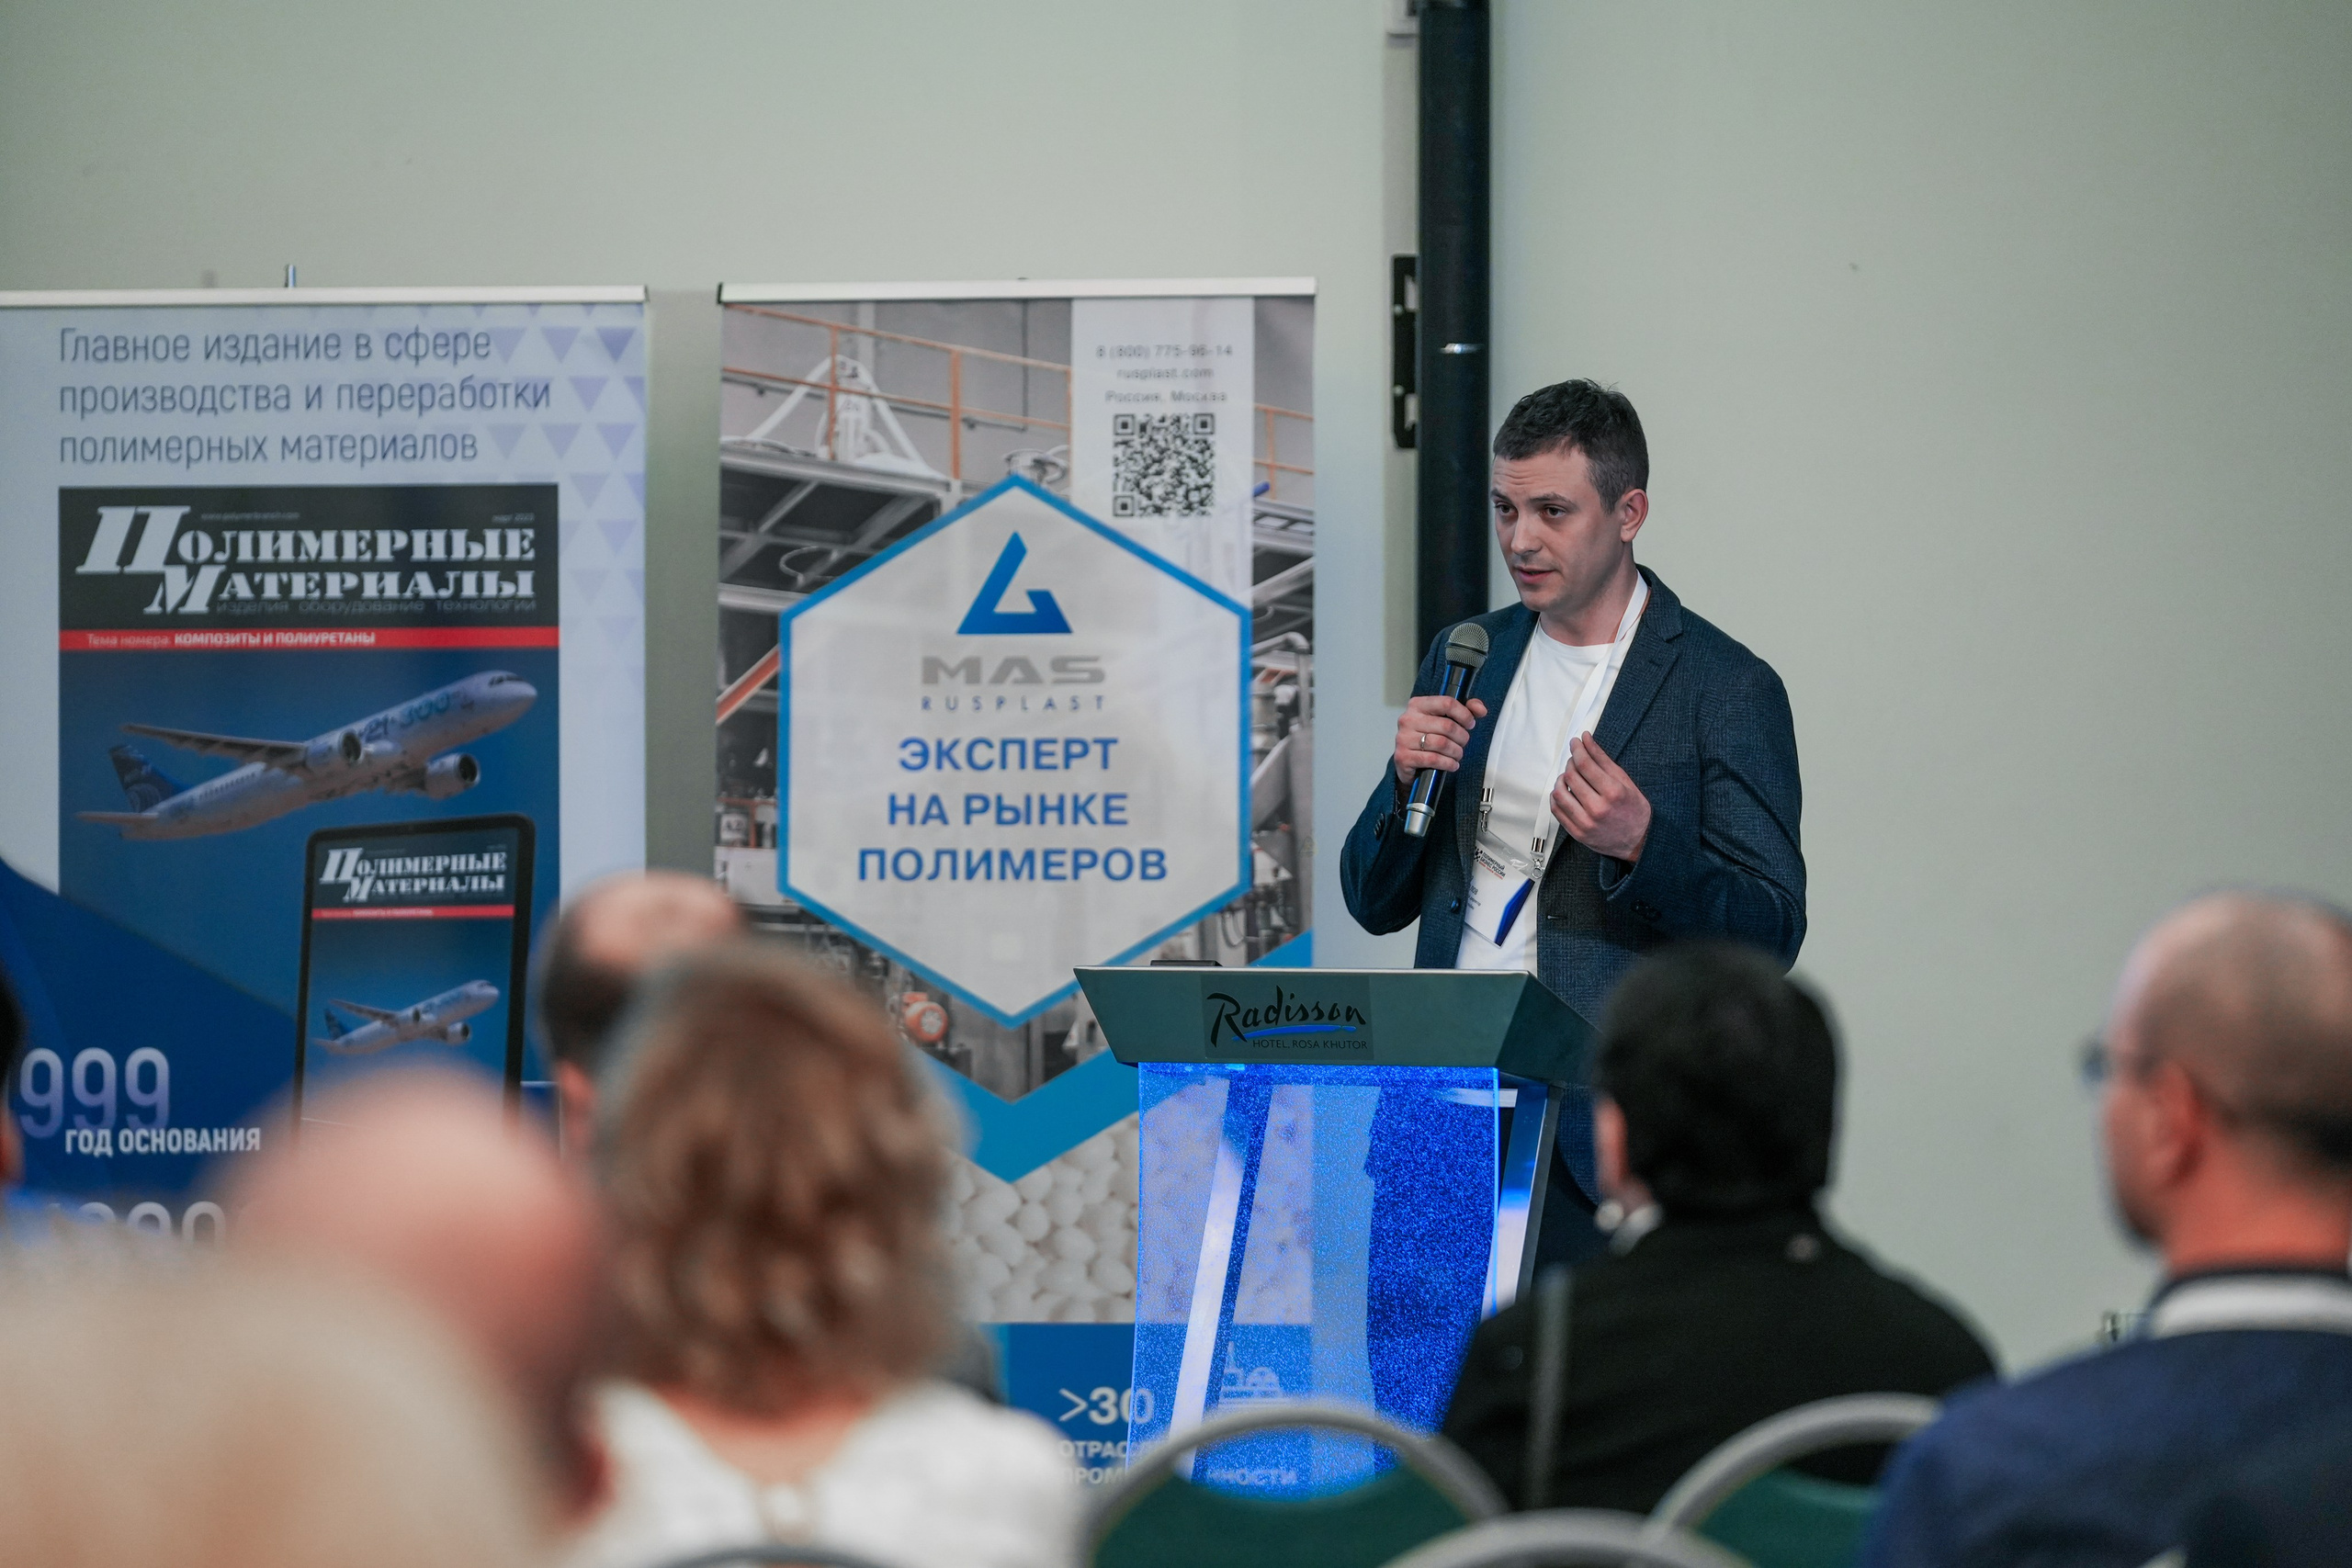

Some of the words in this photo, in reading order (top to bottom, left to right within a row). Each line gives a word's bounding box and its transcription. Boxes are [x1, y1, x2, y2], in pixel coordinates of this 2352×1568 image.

[60, 327, 190, 363] Главное
[204, 333, 342, 368] издание
[356, 333, 373, 360] в
[384, 324, 491, 367] сфере
[1096, 344, 1106, 359] 8
[1109, 344, 1150, 359] (800)
[1116, 367, 1214, 380] rusplast.com
[60, 384, 291, 421] производства
[305, 384, 322, 411] и
[337, 374, 551, 419] переработки
[1170, 389, 1227, 403] Москва
[60, 434, 269, 470] полимерных
[281, 433, 478, 469] материалов
[216, 601, 288, 615] изделия
[299, 600, 425, 616] оборудование
[436, 599, 537, 613] технологии
[86, 633, 118, 647] Тема
[174, 632, 261, 648] КОМПОЗИТЫ
[263, 632, 274, 647] И
[277, 631, 376, 647] ПОЛИУРЕТАНЫ
[922, 656, 1105, 684] MAS
[921, 694, 1105, 712] RUSPLAST
[898, 737, 1119, 772] ЭКСПЕРТ
[888, 794, 949, 826] НА
[963, 794, 1128, 826] РЫНКЕ
[858, 848, 1168, 882] ПОЛИМЕРОВ
[1206, 985, 1366, 1048] Radisson
[1292, 1039, 1320, 1049] ROSA
[1323, 1039, 1368, 1050] KHUTOR
[17, 1046, 171, 1139] 999
[64, 1128, 114, 1158] ГОД
[119, 1126, 261, 1155] ОСНОВАНИЯ
[1058, 1386, 1154, 1426] >30
